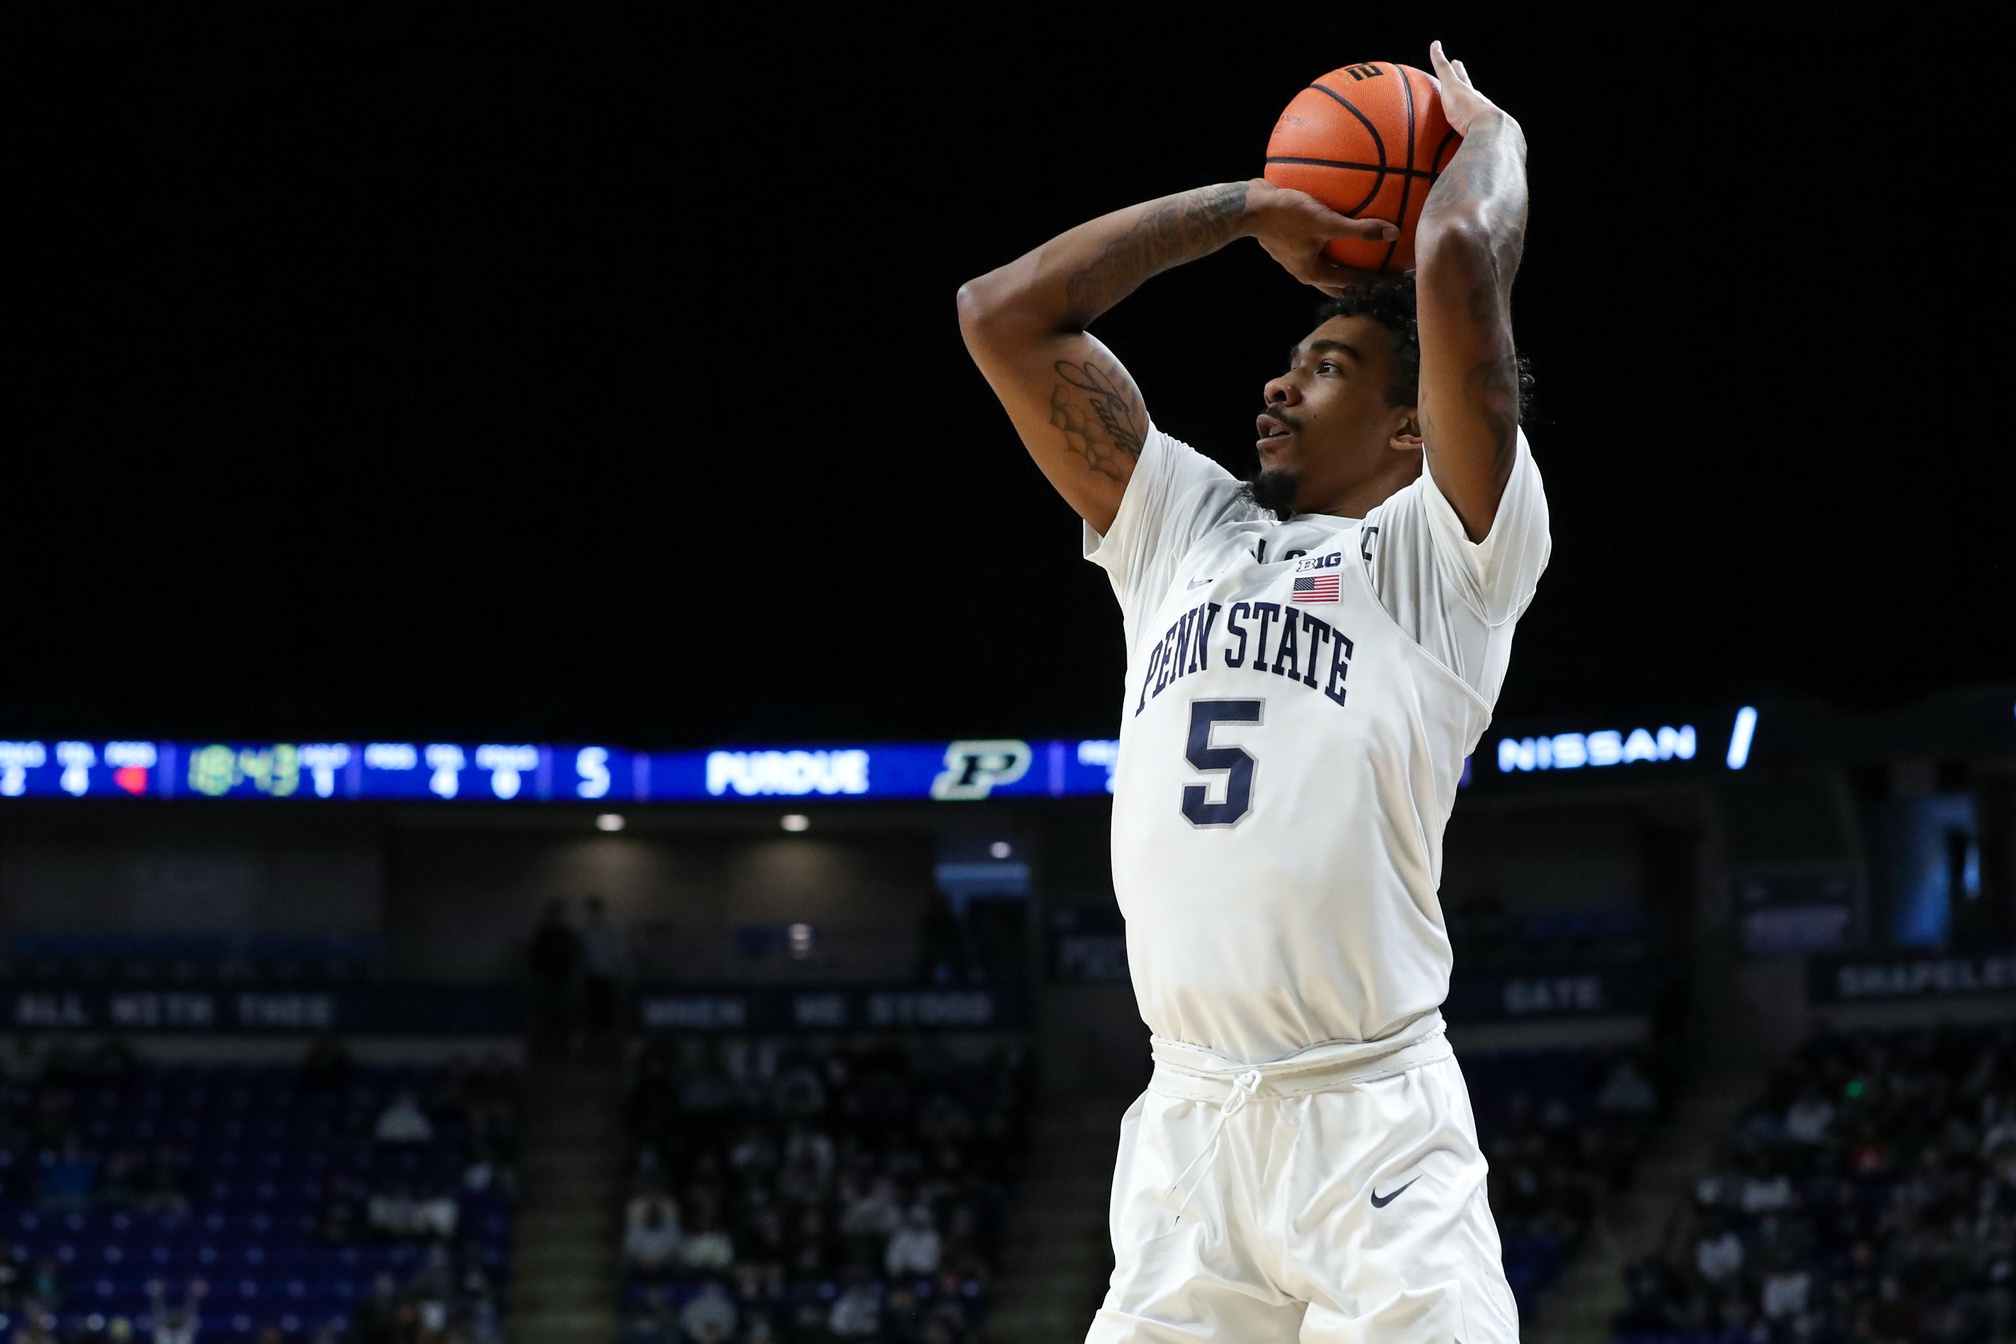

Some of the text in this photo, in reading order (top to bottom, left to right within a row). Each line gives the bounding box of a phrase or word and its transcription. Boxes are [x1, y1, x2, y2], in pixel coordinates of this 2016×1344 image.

[1135, 601, 1354, 718] PENN STATE
[576, 747, 611, 799] 5
[707, 750, 870, 796] PURDUE
[929, 739, 1032, 800] P
[1179, 697, 1266, 829] 5
[1498, 724, 1697, 773] NISSAN
[14, 991, 88, 1027] ALL
[109, 991, 215, 1027] WITH
